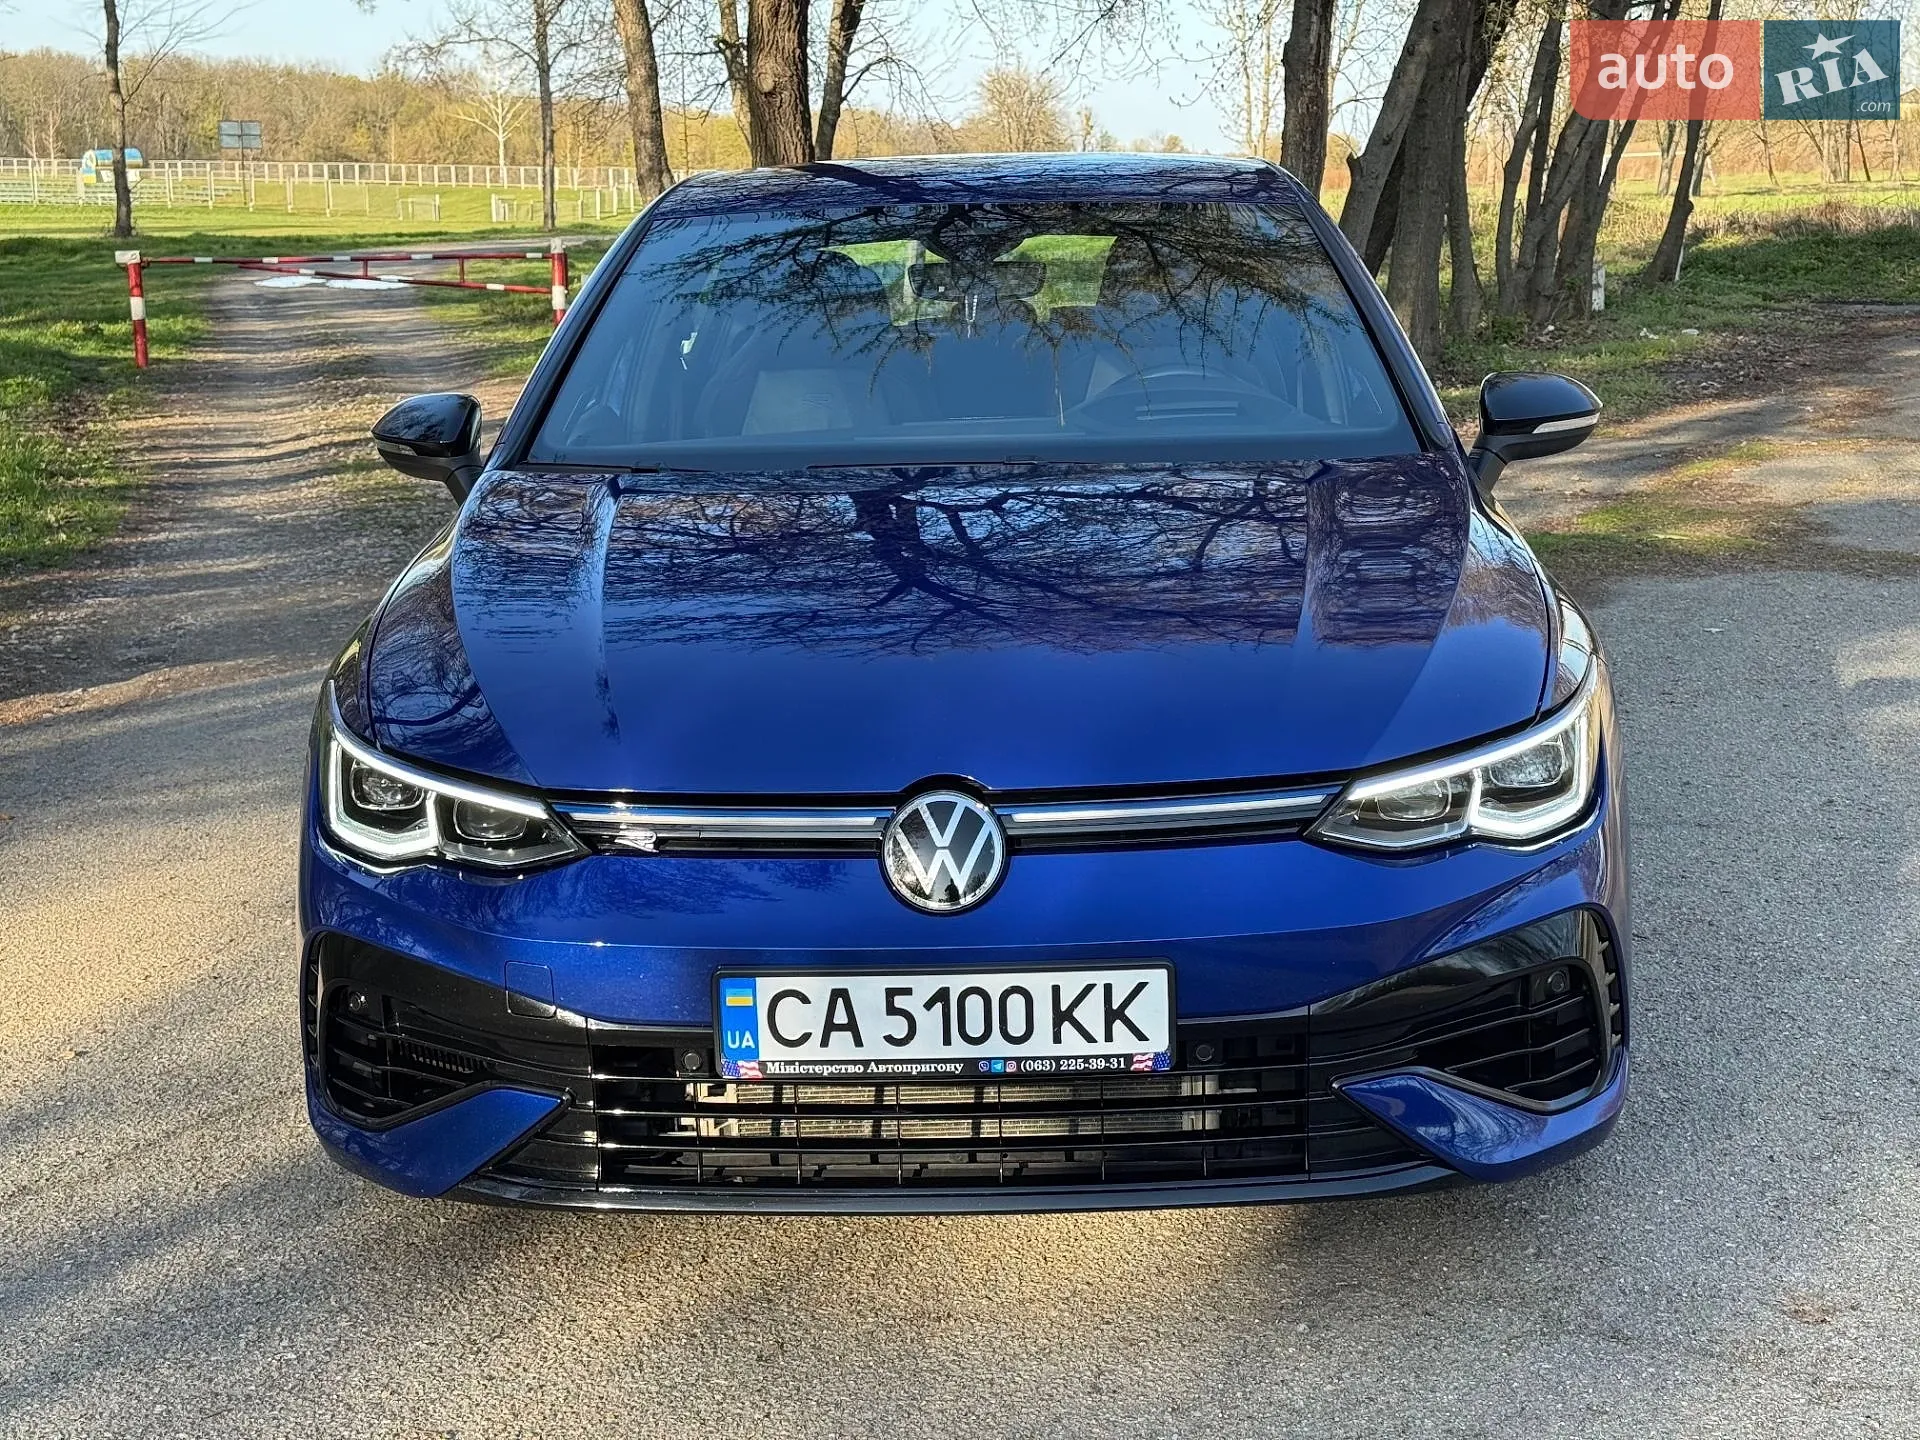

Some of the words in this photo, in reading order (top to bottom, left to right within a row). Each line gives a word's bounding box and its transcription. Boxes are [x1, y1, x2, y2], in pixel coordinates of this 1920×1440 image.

[766, 988, 864, 1048] CA
[882, 985, 1034, 1047] 5100
[1051, 981, 1150, 1044] KK
[727, 1031, 755, 1049] UA
[766, 1061, 864, 1076] Міністерство
[866, 1061, 964, 1074] Автопригону
[1020, 1059, 1056, 1073] (063)
[1060, 1057, 1126, 1071] 225-39-31
